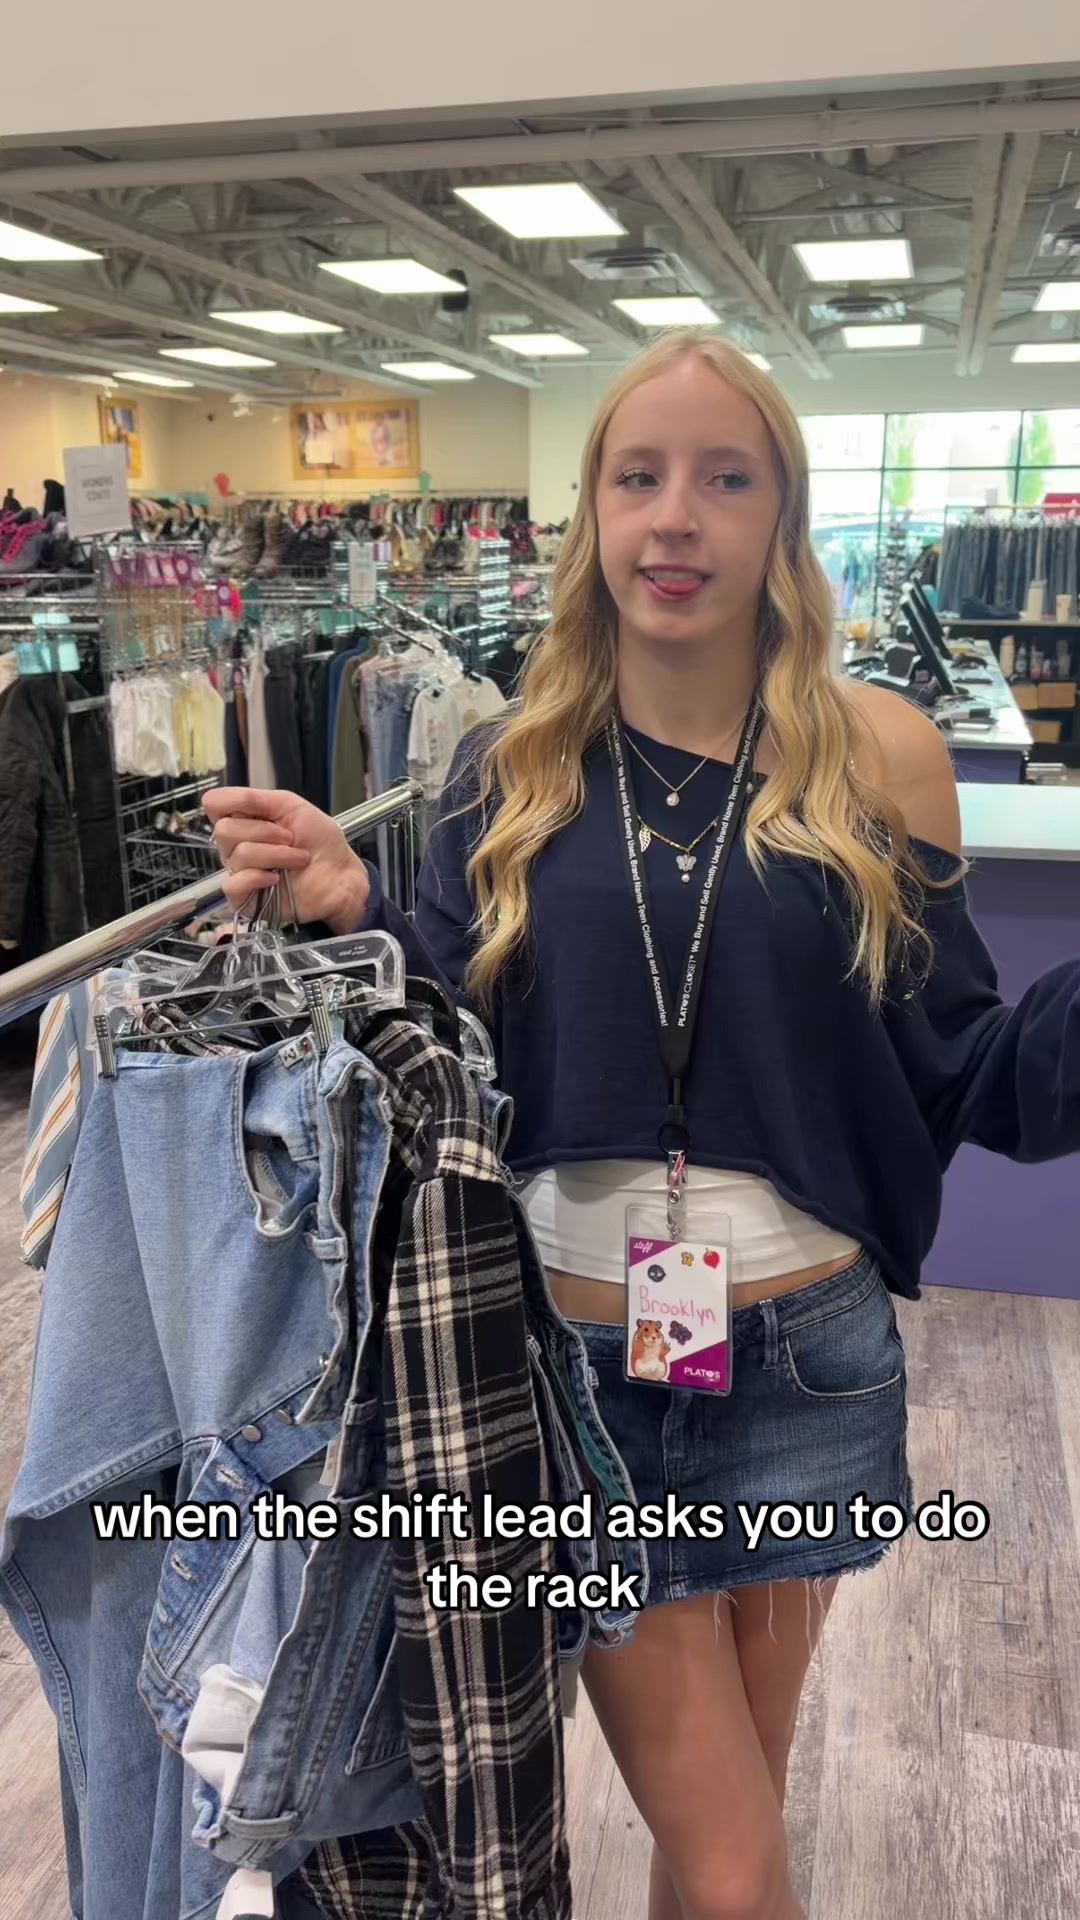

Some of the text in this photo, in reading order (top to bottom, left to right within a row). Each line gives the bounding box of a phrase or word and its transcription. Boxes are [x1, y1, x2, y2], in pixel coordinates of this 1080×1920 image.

[743, 739, 752, 754] and
[617, 764, 625, 777] We
[732, 754, 749, 783] Clothing
[621, 791, 630, 805] and
[728, 784, 739, 801] Teen
[622, 804, 631, 818] Sell
[722, 801, 735, 821] Name
[624, 818, 634, 839] Gently
[716, 822, 729, 844] Brand
[627, 840, 637, 860] Used,
[710, 844, 724, 864] Used,
[630, 860, 641, 881] Brand
[704, 865, 718, 888] Gently
[633, 881, 643, 904] Name
[700, 889, 711, 905] Sell
[637, 904, 647, 924] Teen
[698, 906, 707, 921] and
[693, 923, 705, 939] Buy
[641, 924, 655, 959] Clothing
[690, 940, 700, 953] We
[649, 959, 659, 975] and
[652, 975, 669, 1027] Accessories!
[633, 1240, 653, 1253] staff
[639, 1285, 716, 1327] Brooklyn
